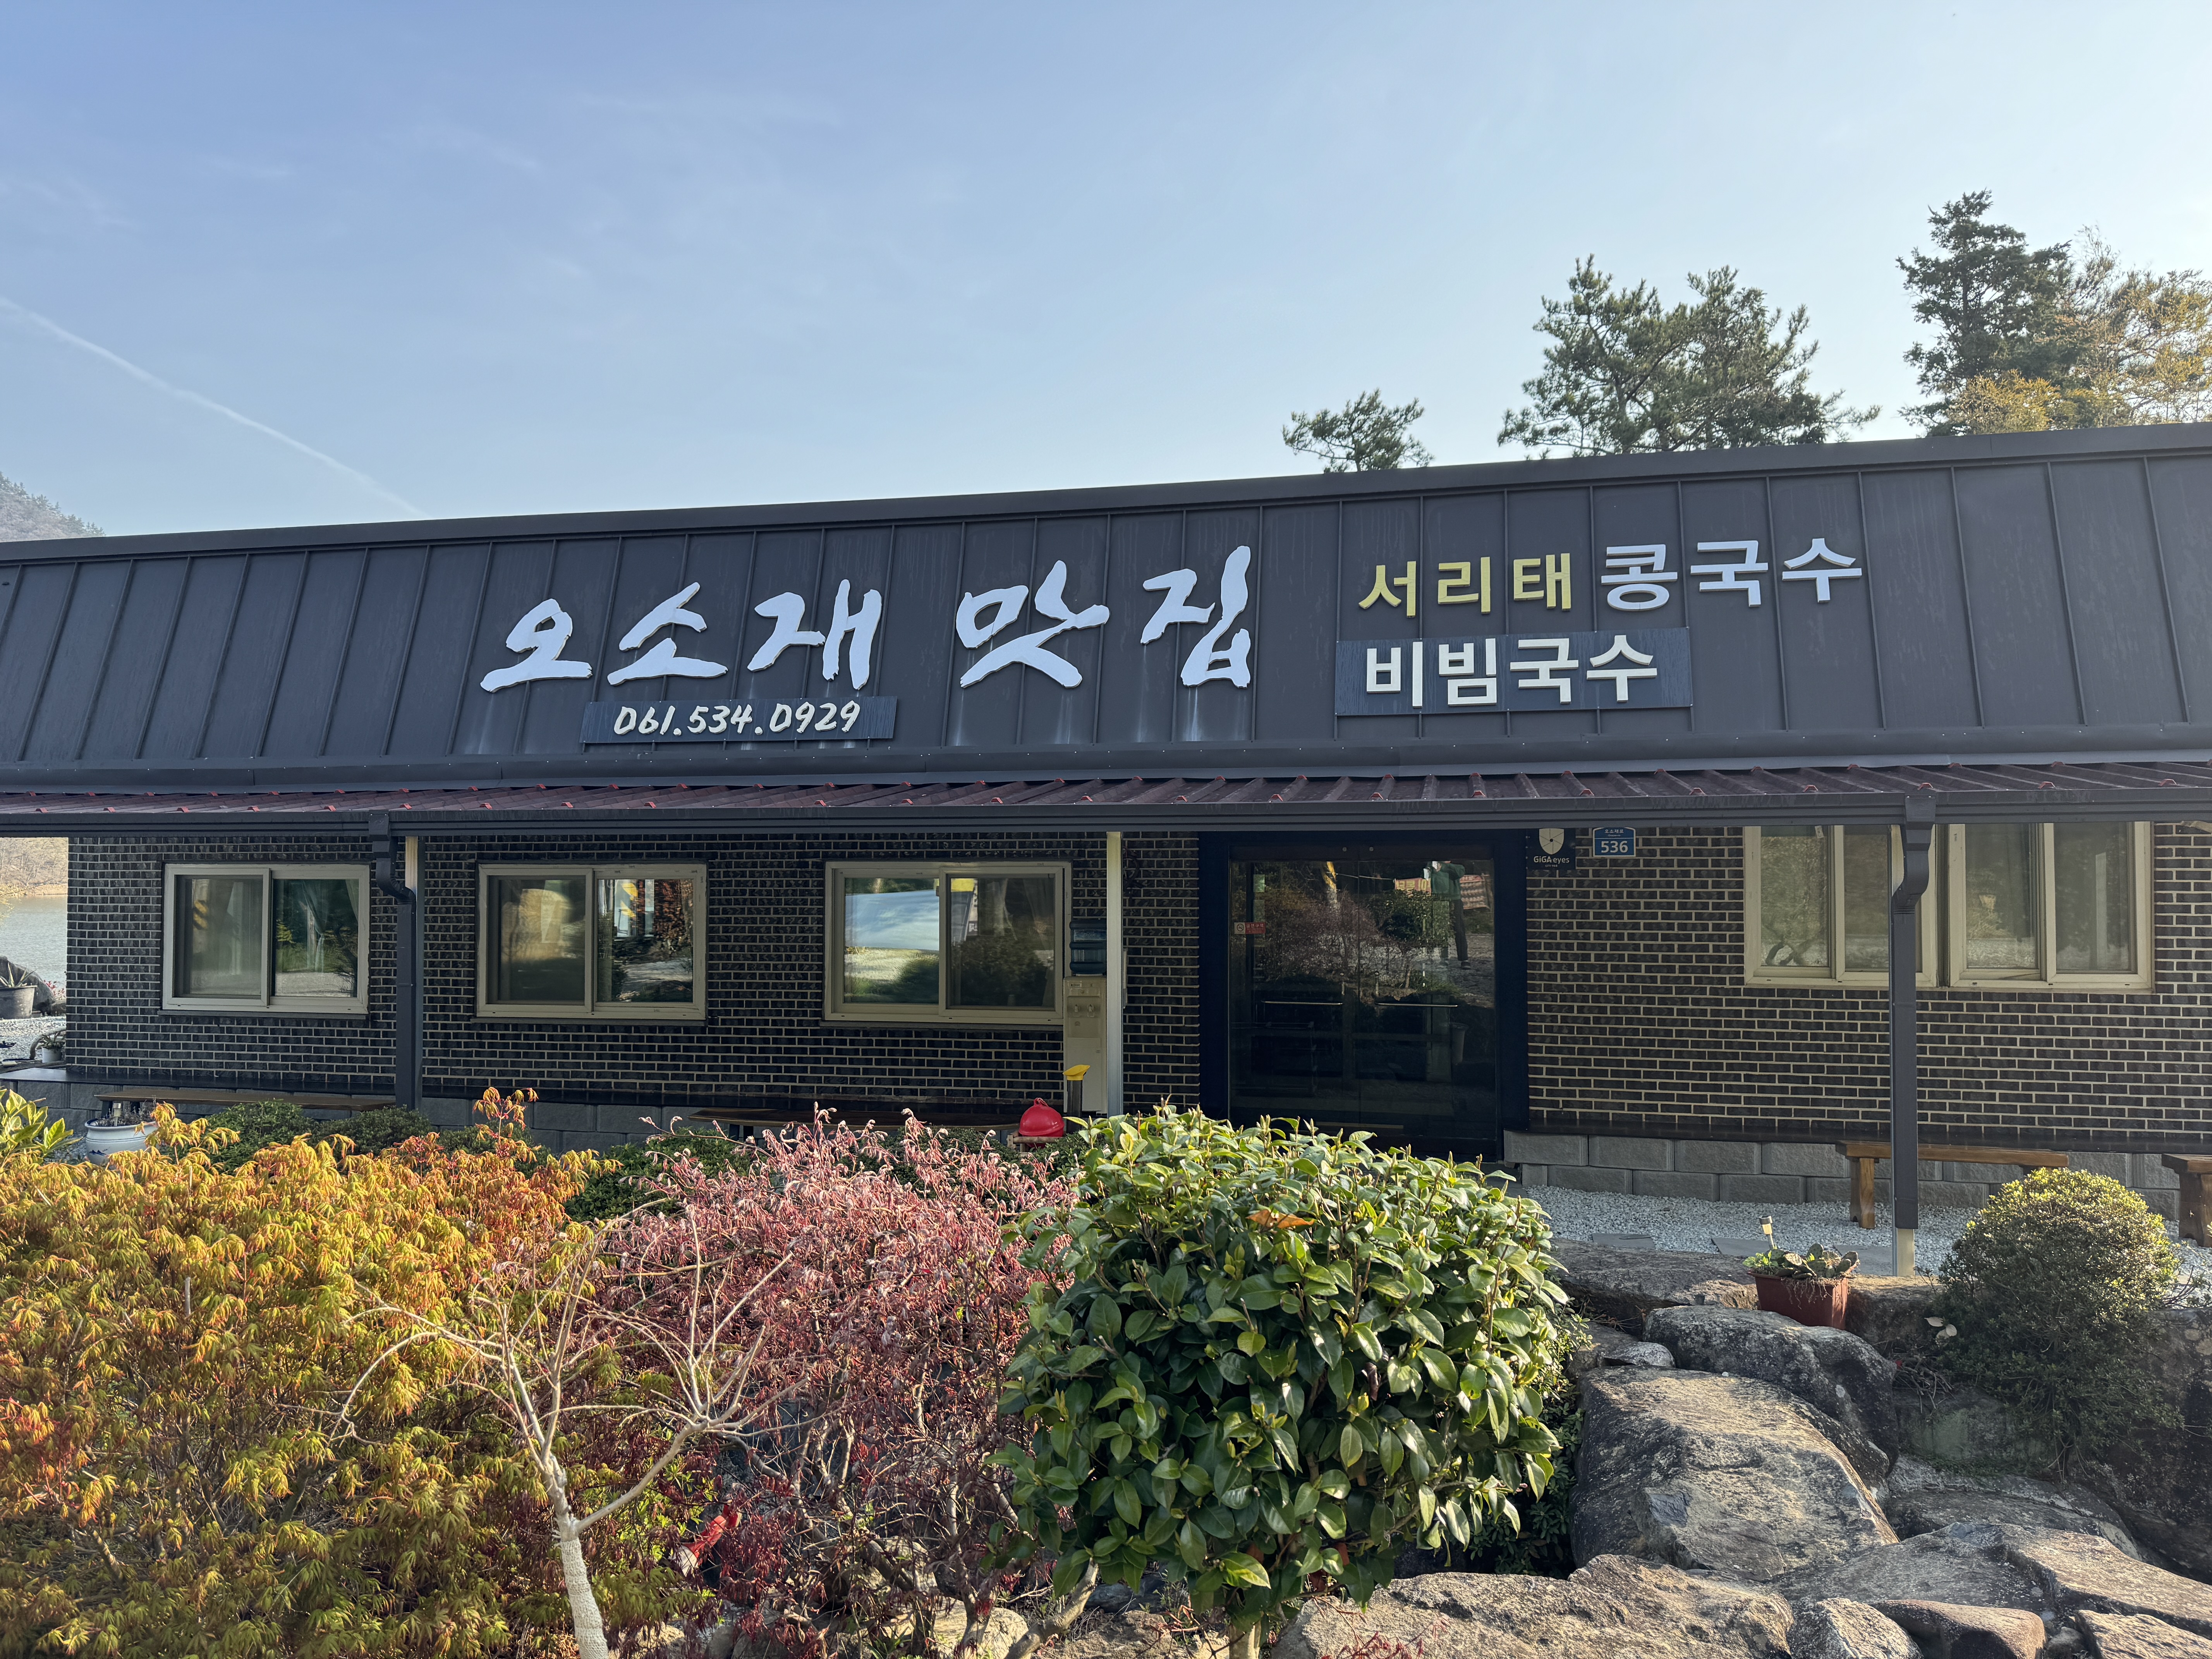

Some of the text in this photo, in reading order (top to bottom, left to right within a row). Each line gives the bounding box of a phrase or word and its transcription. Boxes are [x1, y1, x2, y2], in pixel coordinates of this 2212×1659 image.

[1358, 538, 1862, 617] 서리태 콩국수
[480, 545, 1251, 692] 오소재 맛집
[1366, 635, 1658, 708] 비빔국수
[613, 700, 860, 735] 061.534.0929
[1601, 841, 1628, 853] 536
